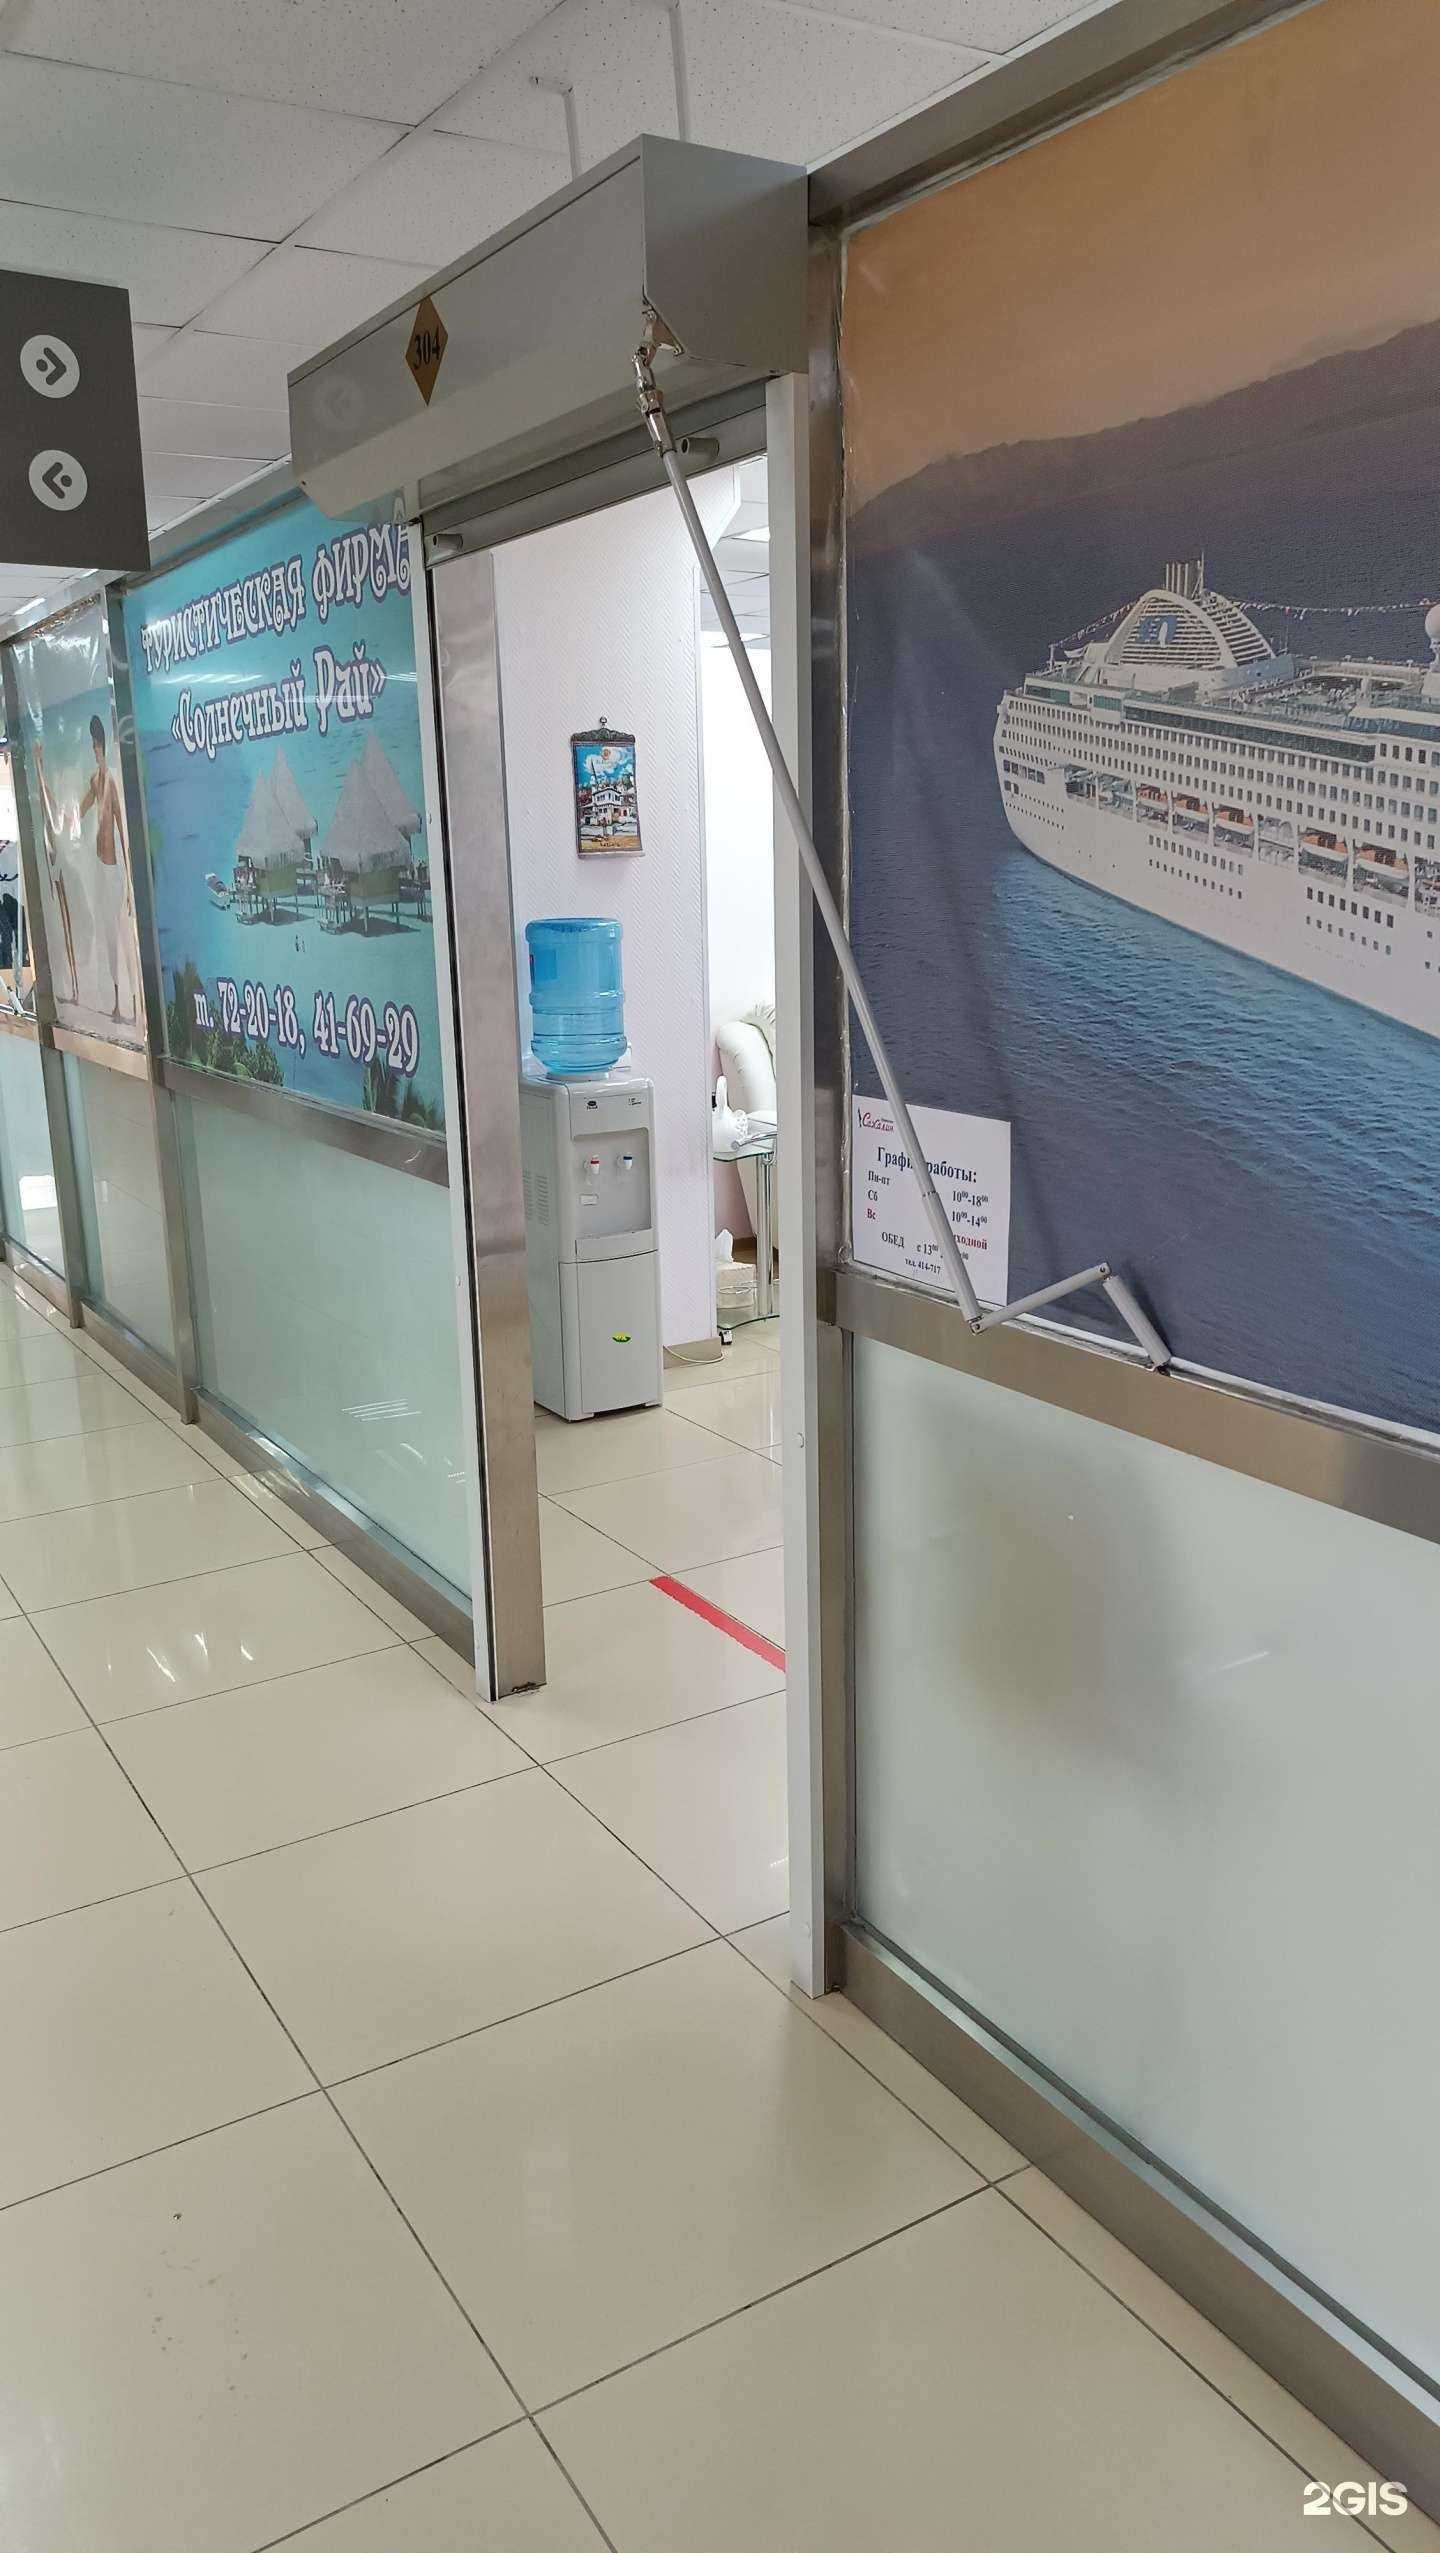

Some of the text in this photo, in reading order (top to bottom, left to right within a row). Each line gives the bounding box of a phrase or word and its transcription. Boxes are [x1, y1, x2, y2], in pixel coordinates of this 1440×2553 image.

[414, 324, 440, 370] 304
[140, 558, 306, 672] ТУРИСТИЧЕСКАЯ
[172, 644, 386, 759] «Солнечный Рай»
[217, 981, 305, 1055] 72-20-18,
[314, 995, 418, 1073] 41-69-29
[867, 1189, 878, 1202] Сб
[867, 1208, 876, 1220] Вс
[881, 1231, 905, 1248] ОБЕД
